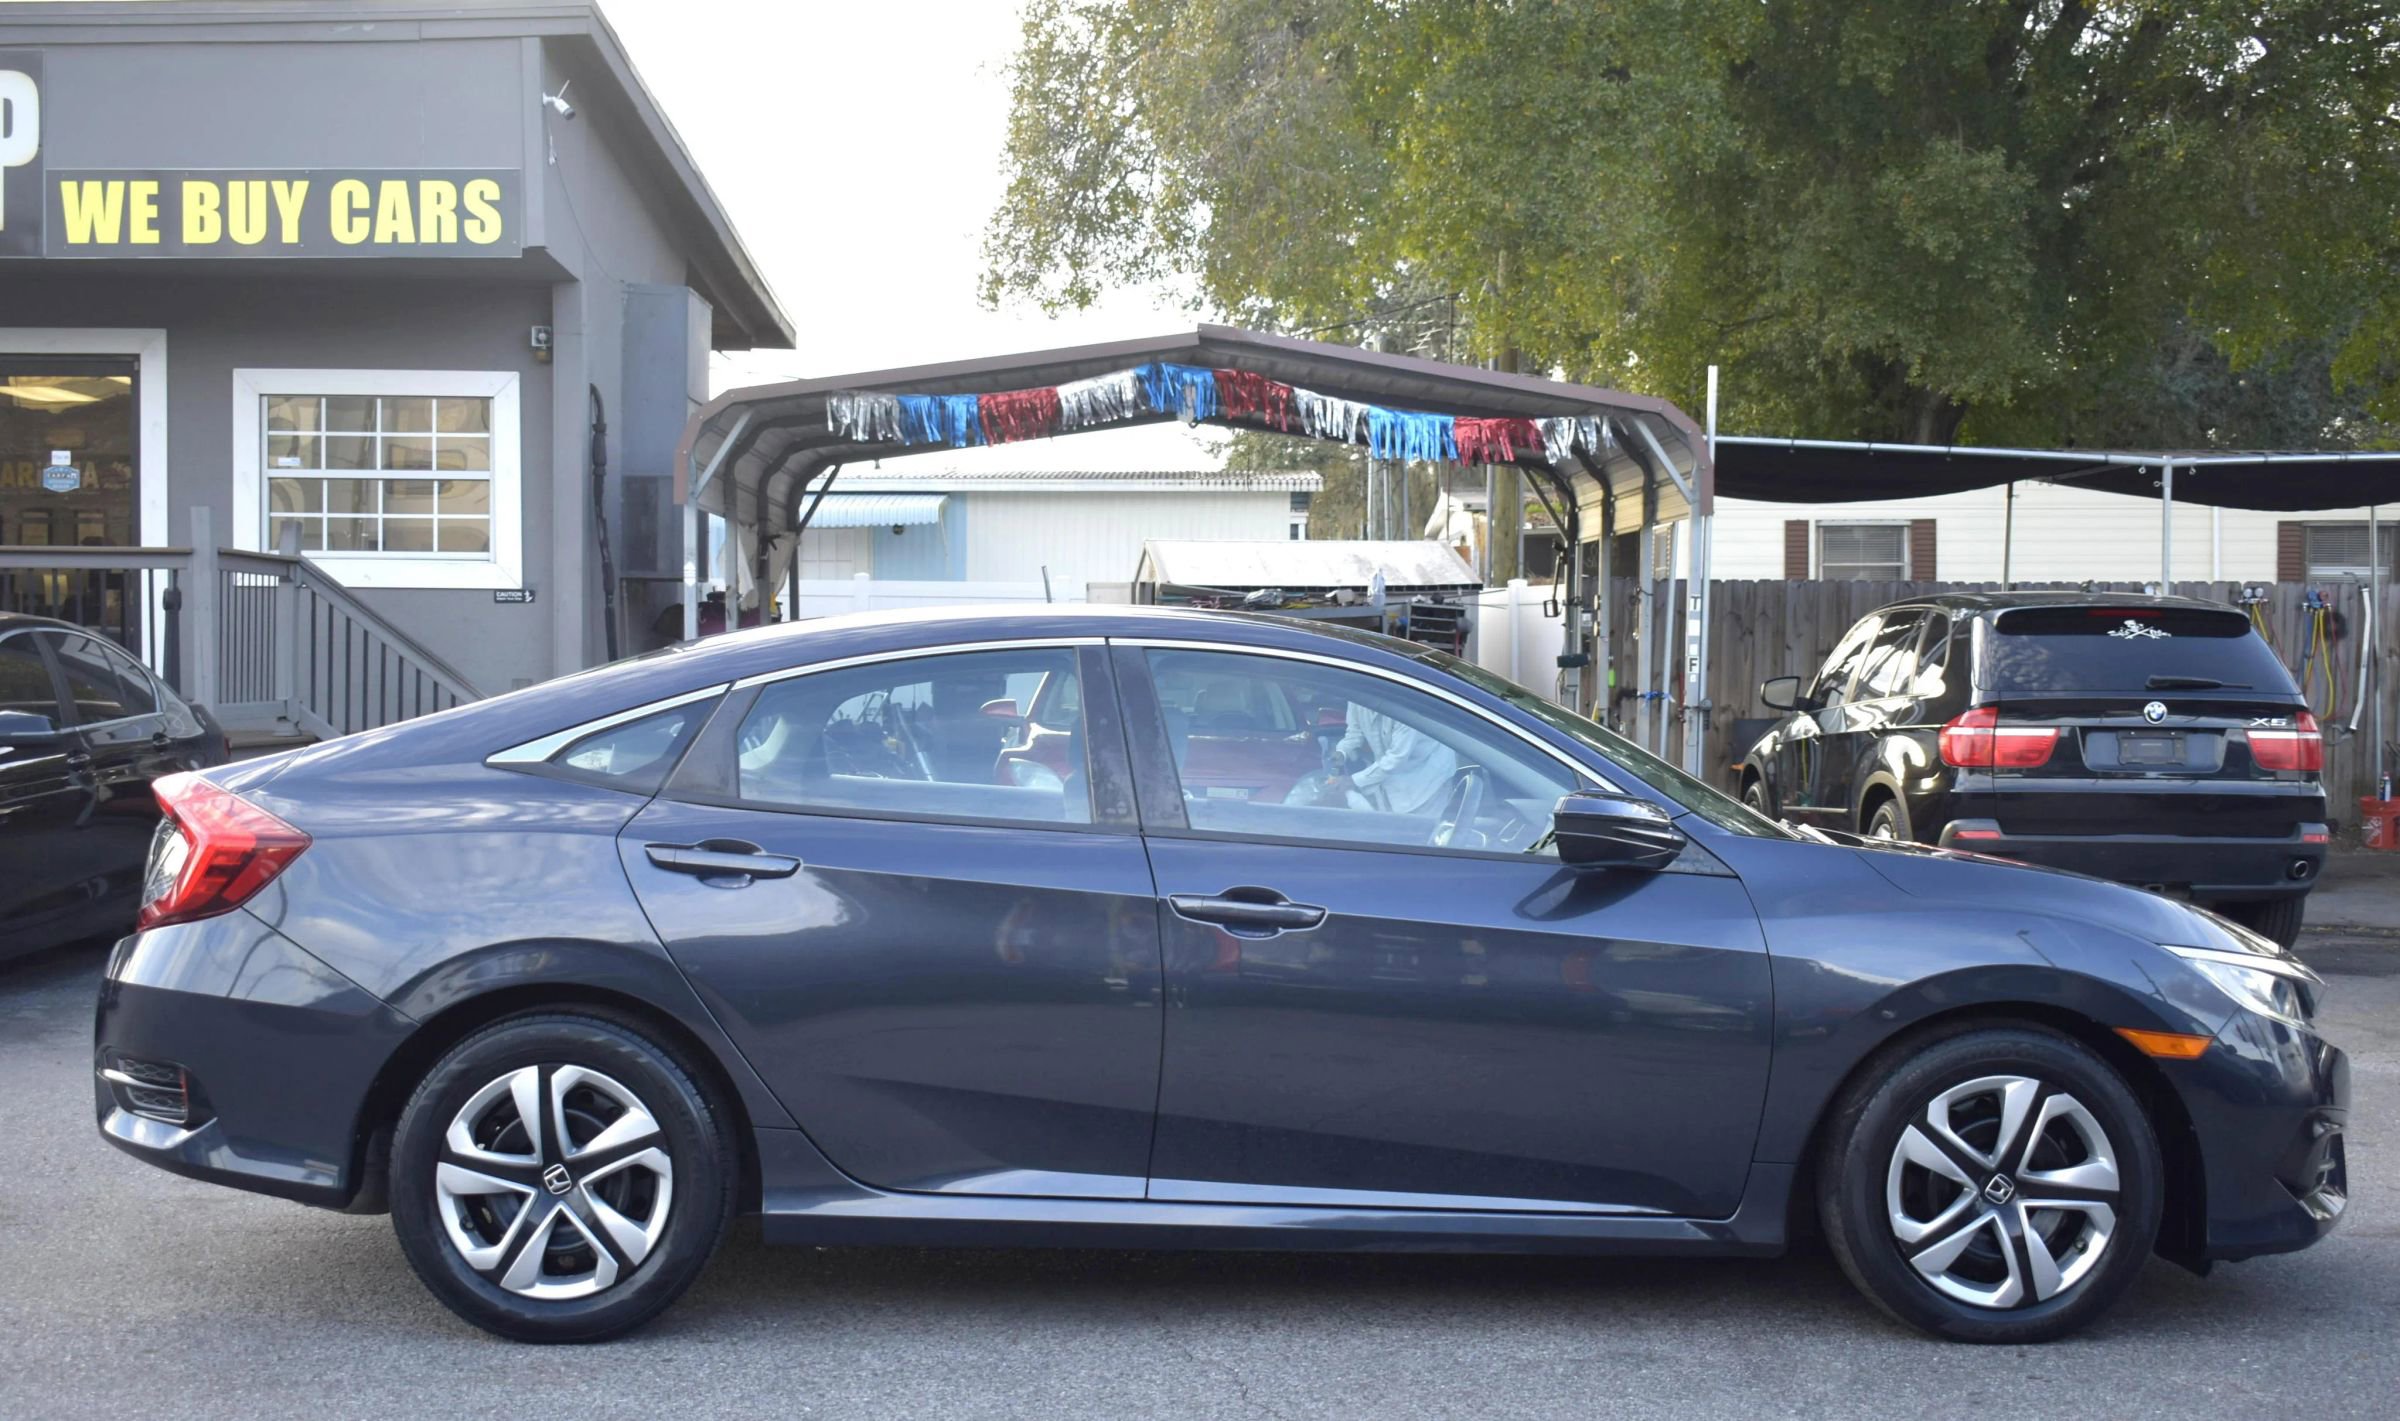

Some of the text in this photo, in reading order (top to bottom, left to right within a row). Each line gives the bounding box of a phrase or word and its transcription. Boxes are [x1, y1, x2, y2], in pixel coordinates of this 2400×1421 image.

[60, 178, 502, 245] WE BUY CARS
[1689, 657, 1698, 672] F
[2250, 717, 2287, 727] X5
